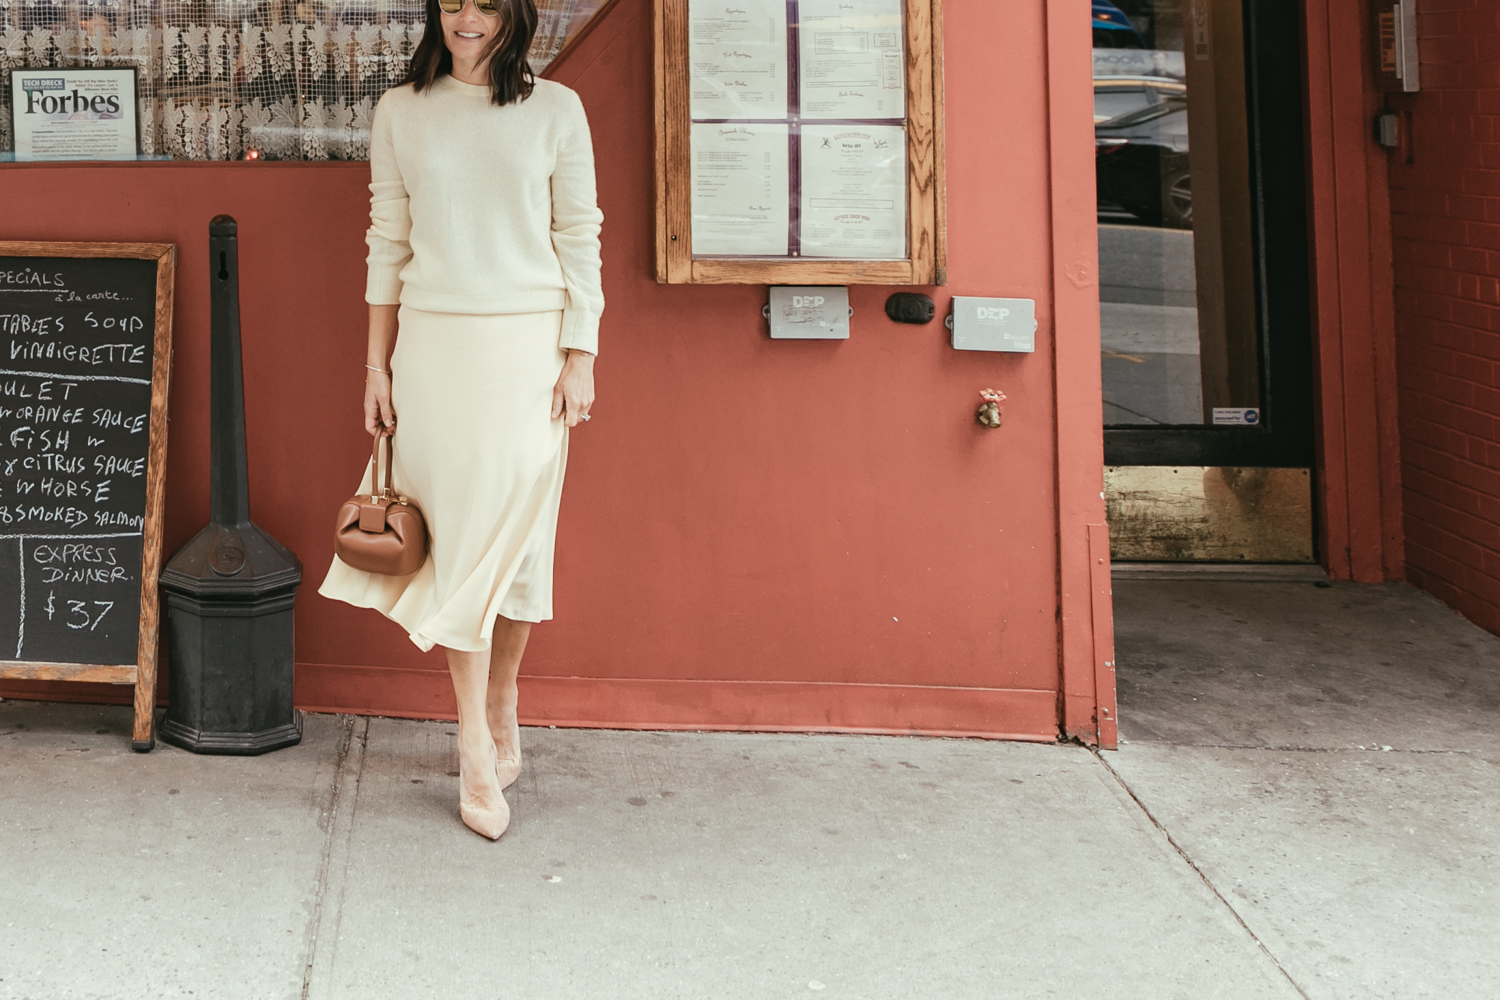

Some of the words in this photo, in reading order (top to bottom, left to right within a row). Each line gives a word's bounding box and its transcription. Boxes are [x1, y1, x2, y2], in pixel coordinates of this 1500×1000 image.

[23, 79, 40, 87] TECH
[23, 89, 120, 115] Forbes
[84, 311, 144, 331] SOUP
[15, 405, 84, 424] ORANGE
[92, 408, 147, 433] SAUCE
[10, 426, 70, 451] FISH
[23, 453, 85, 473] CITRUS
[93, 454, 145, 478] SAUCE
[40, 475, 111, 502] HORSE
[16, 504, 89, 529] SMOKED
[94, 509, 146, 533] SALMON
[33, 543, 118, 566] EXPRESS
